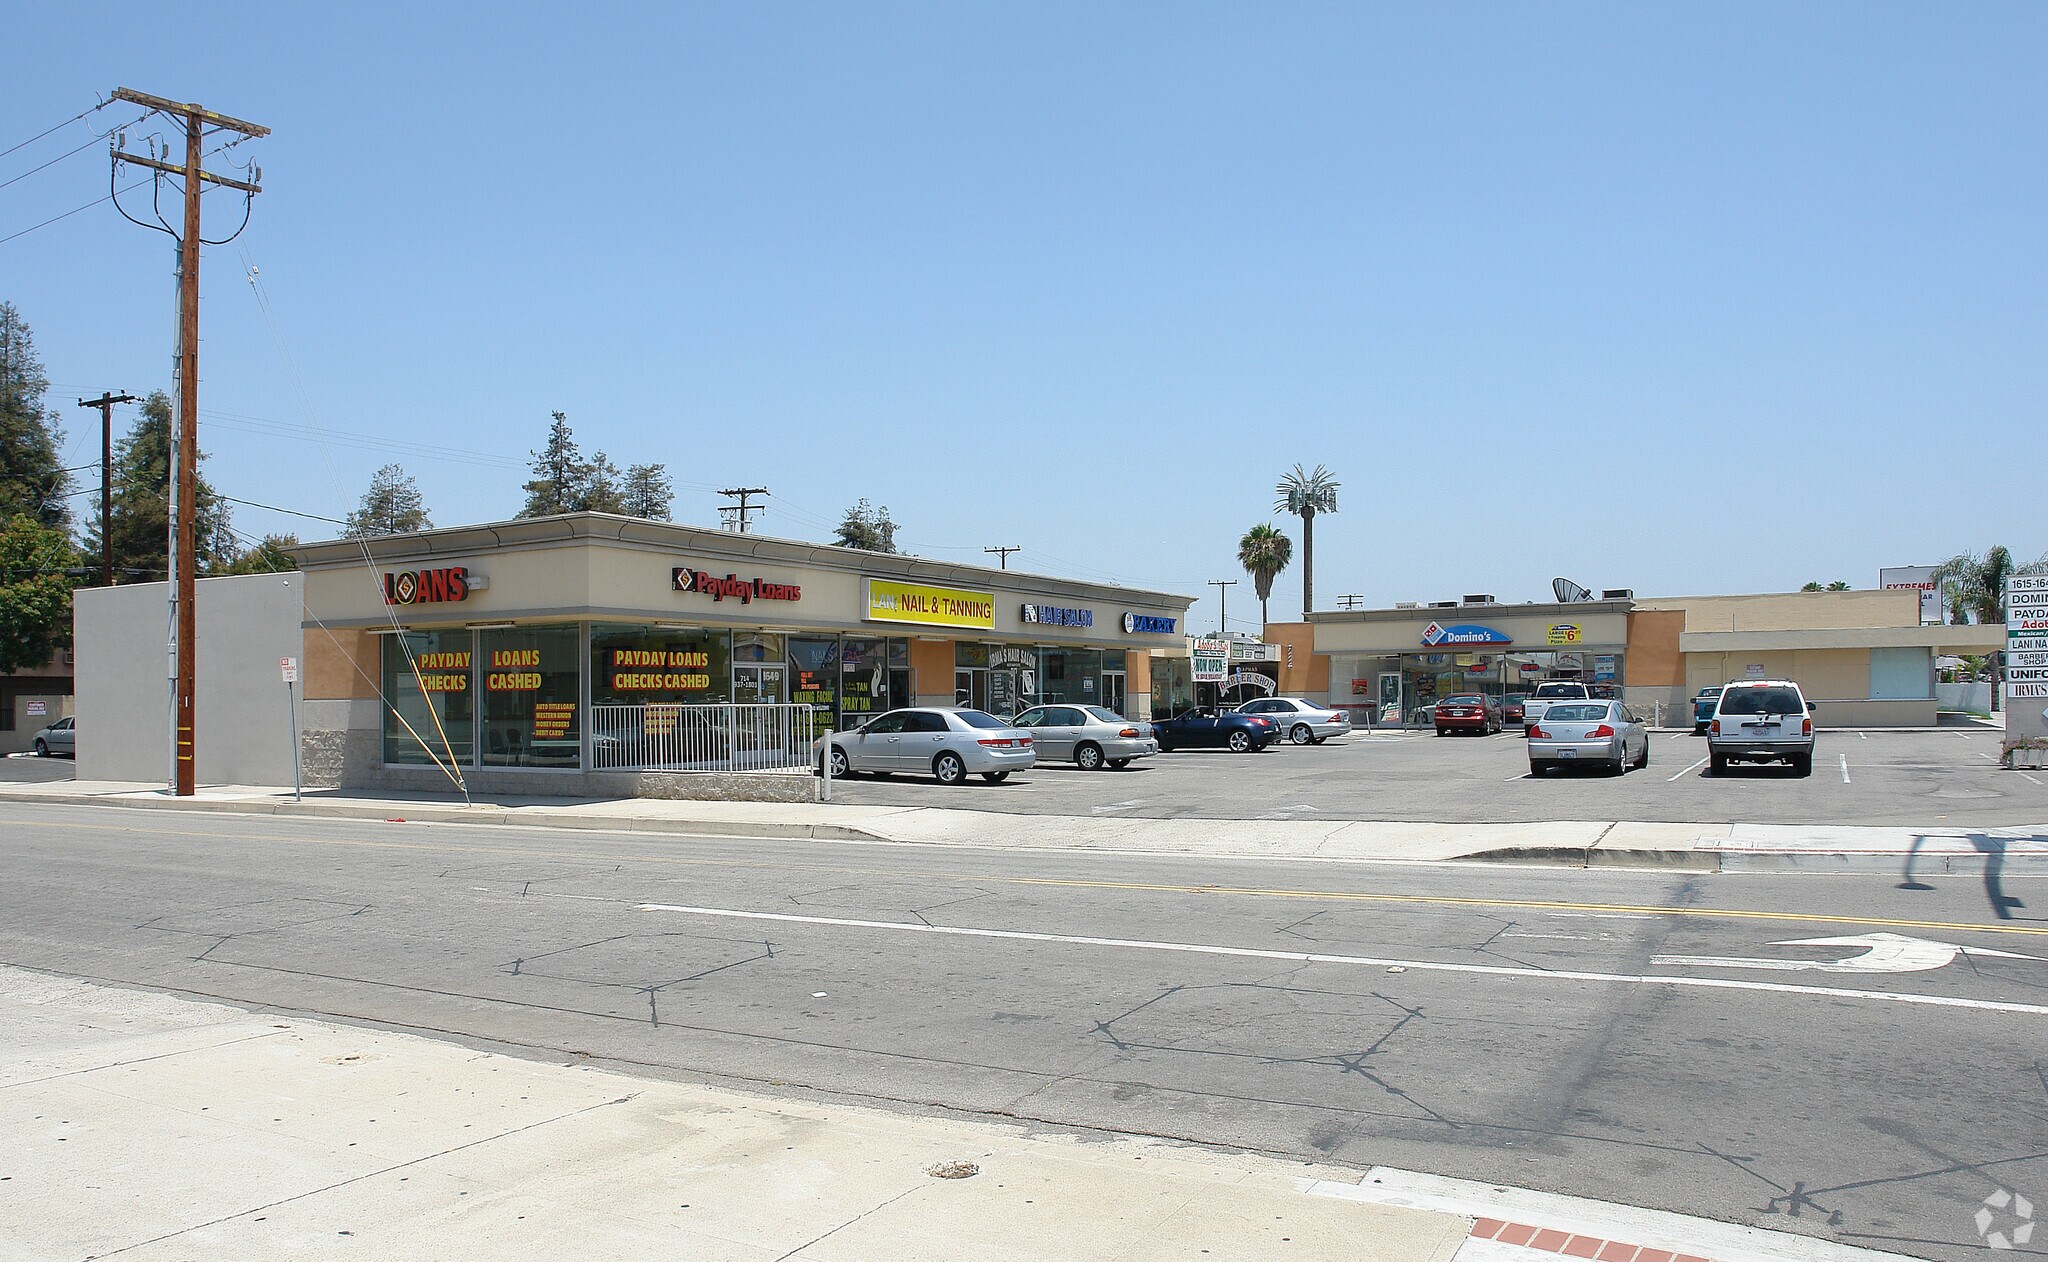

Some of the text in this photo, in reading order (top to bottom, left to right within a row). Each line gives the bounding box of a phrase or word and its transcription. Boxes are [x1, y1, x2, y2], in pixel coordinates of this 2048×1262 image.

[384, 567, 469, 605] LOANS
[697, 571, 801, 605] Payday Loans
[901, 594, 928, 613] NAIL
[931, 596, 939, 614] &
[942, 598, 991, 619] TANNING
[1038, 605, 1093, 628] HAIR SALON
[1133, 614, 1178, 634] BAKERY
[1447, 631, 1491, 642] Domino's
[2012, 640, 2033, 649] LANI
[419, 650, 541, 669] PAYDAY LOANS
[614, 650, 709, 668] PAYDAY LOANS
[1007, 648, 1020, 662] HAIR
[1020, 649, 1037, 669] SALON
[1196, 659, 1223, 672] NOW OPEN
[418, 673, 542, 692] CHECKS CASHED
[613, 673, 710, 690] CHECKS CASHED
[762, 671, 780, 681] 1649
[1218, 672, 1275, 691] BARER SHOP
[857, 682, 868, 692] TAN
[842, 696, 871, 711] SPRAY TAN
